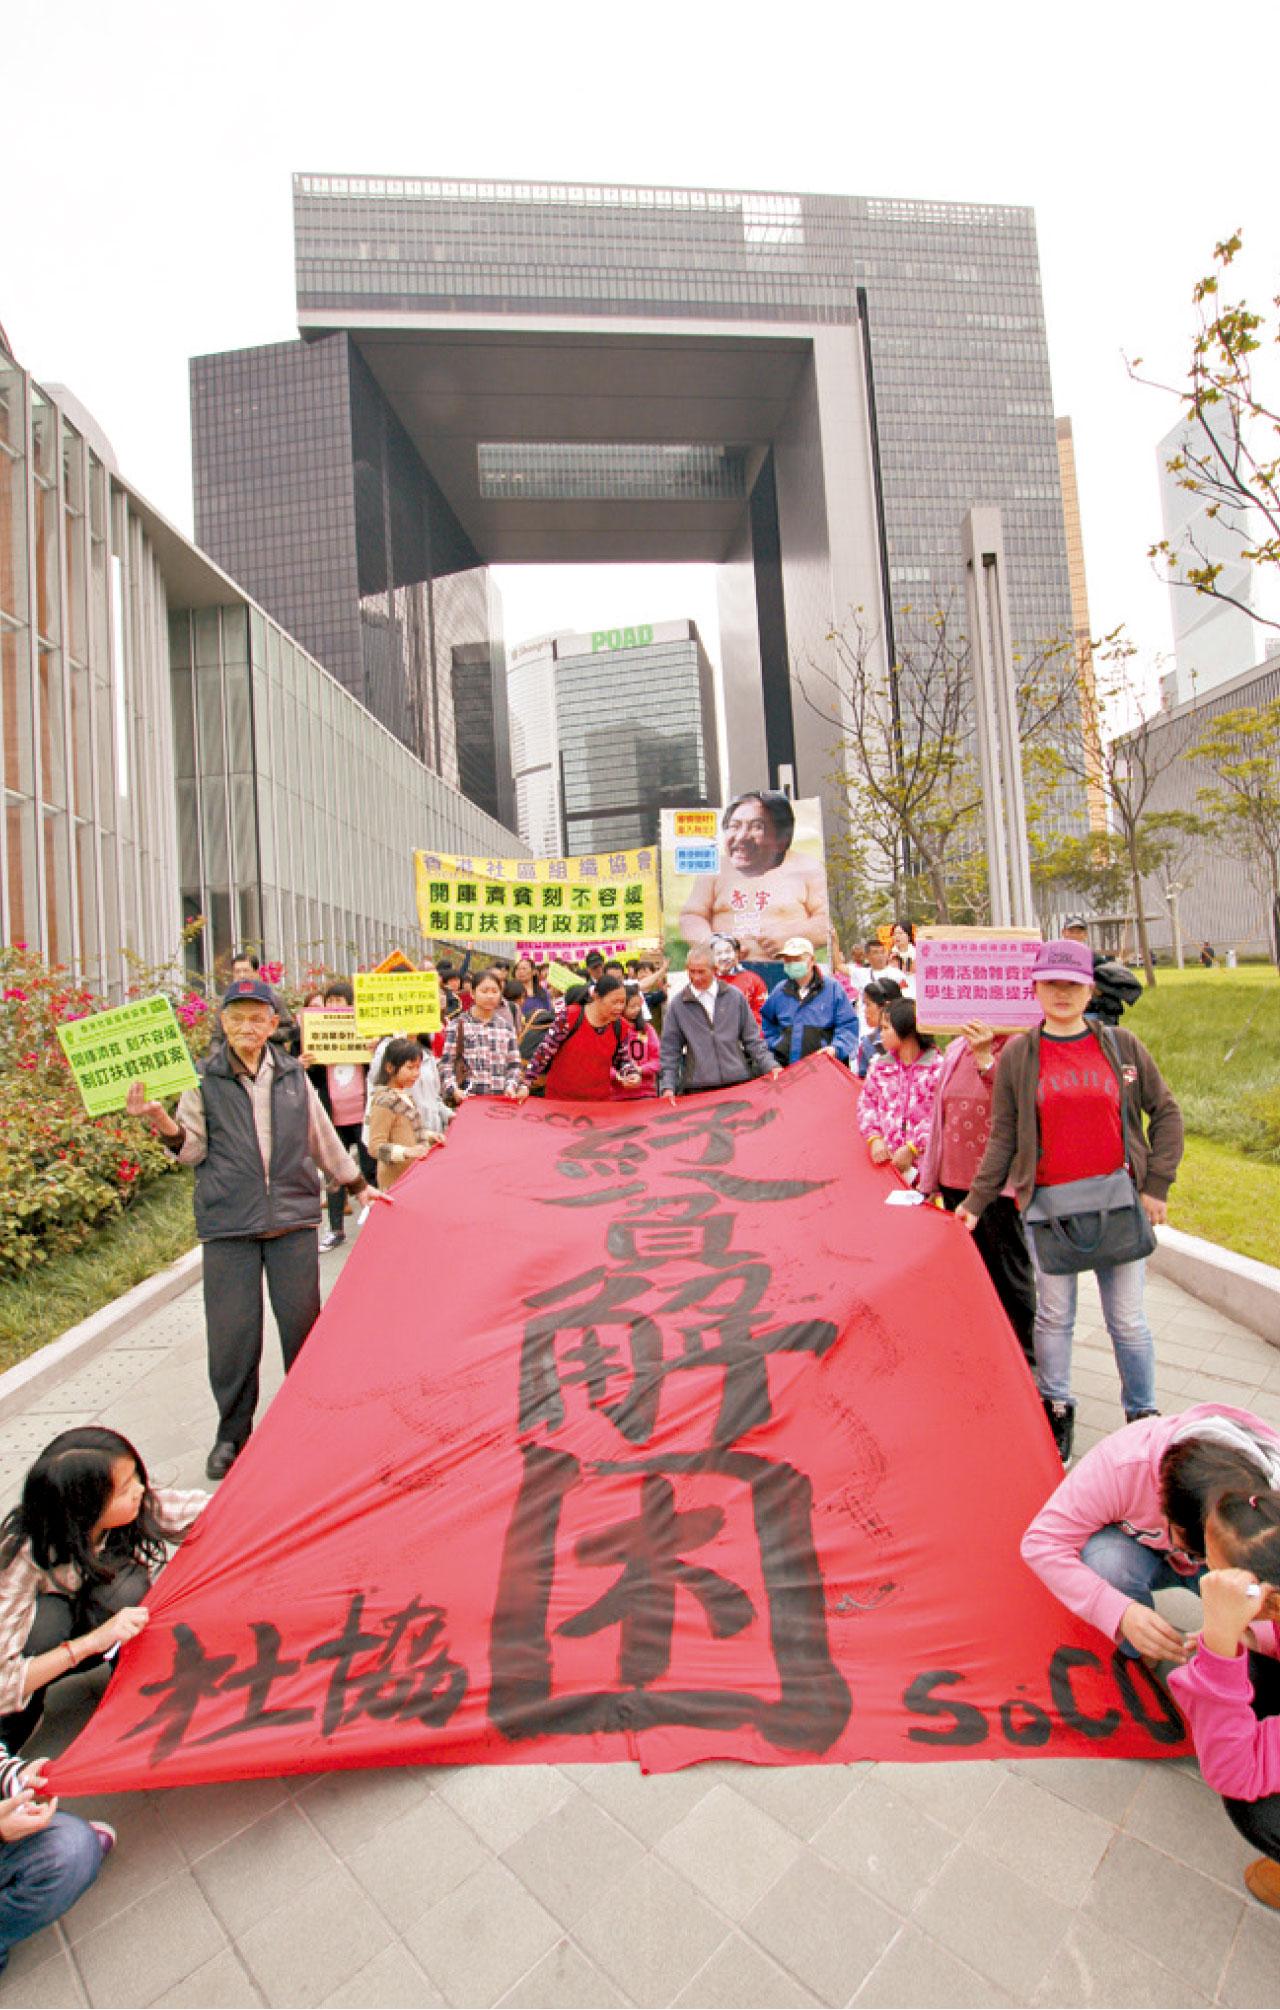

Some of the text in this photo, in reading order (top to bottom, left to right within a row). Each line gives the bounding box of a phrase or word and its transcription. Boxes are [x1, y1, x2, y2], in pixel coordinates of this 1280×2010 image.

[592, 624, 654, 653] POAD
[429, 882, 644, 908] 開庫濟貧刻不容緩
[429, 909, 644, 934] 制訂扶貧財政預算案
